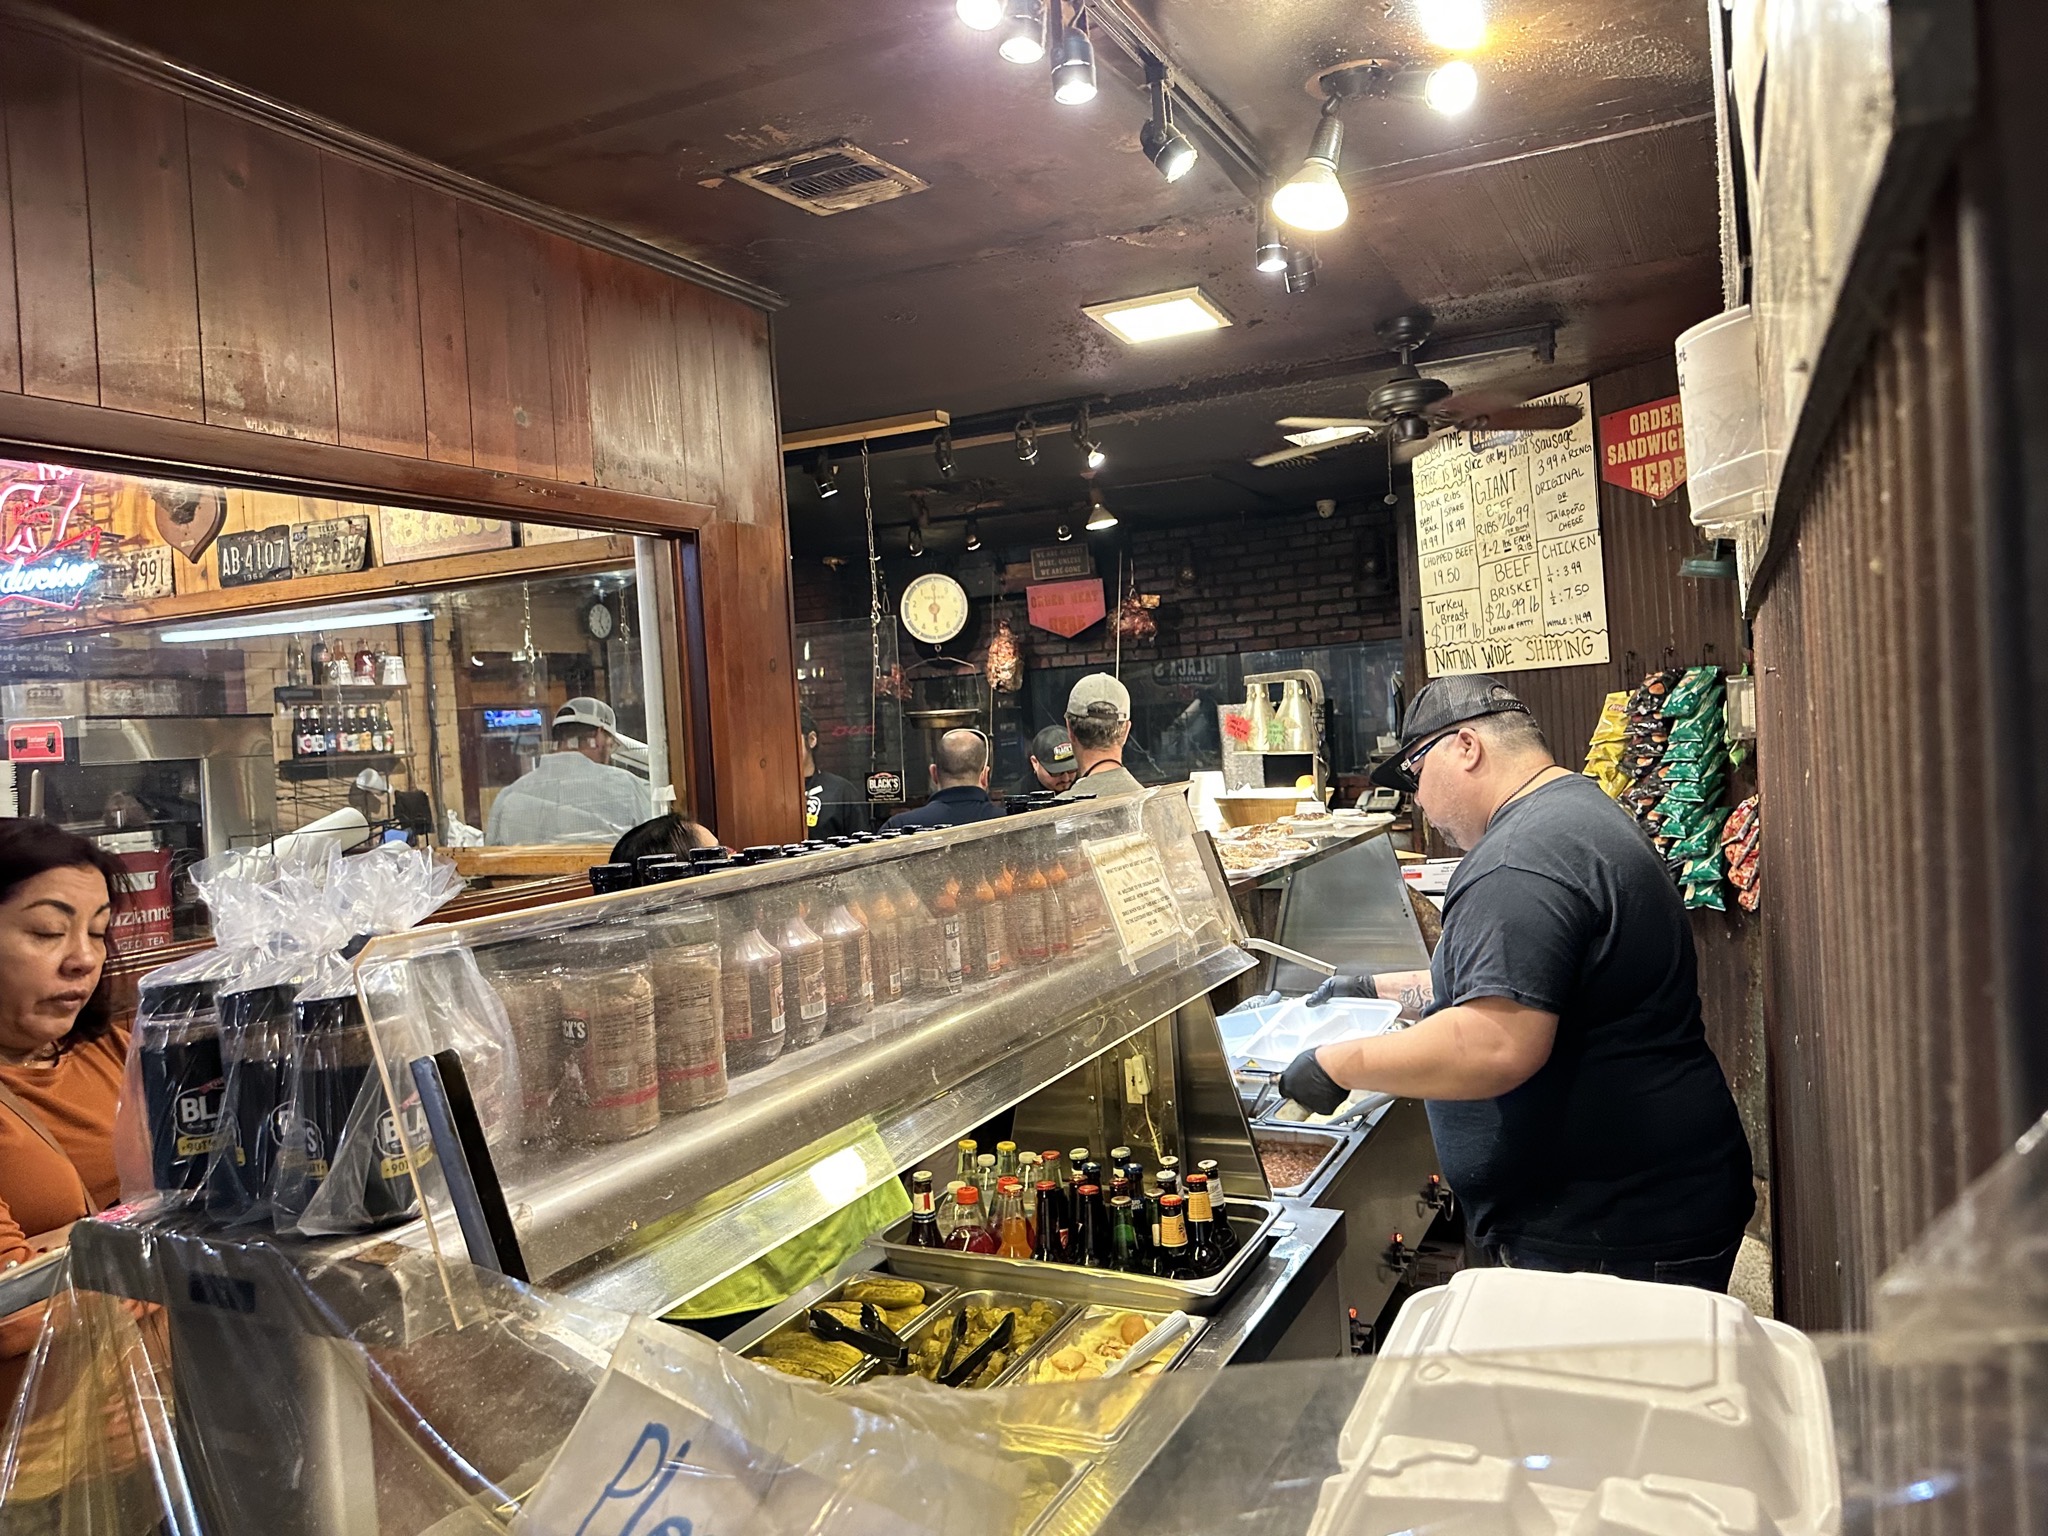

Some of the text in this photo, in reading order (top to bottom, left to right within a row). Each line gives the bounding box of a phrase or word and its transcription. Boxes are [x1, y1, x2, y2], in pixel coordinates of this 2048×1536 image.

[1629, 402, 1682, 436] ORDER
[1474, 468, 1518, 505] GIANT
[1535, 467, 1585, 496] ORIGINAL
[1630, 455, 1687, 497] HERE
[1423, 543, 1474, 569] CHOPPED BEEF
[1541, 534, 1597, 560] CHICKEN
[1493, 556, 1532, 582] BEEF
[1489, 577, 1540, 602] BRISKET
[1484, 597, 1527, 626] $26.99
[1489, 625, 1506, 635] LEAN
[1433, 636, 1594, 673] NATION WIDE SHIPPING
[869, 777, 899, 790] BLACK'S
[146, 936, 165, 947] TEA
